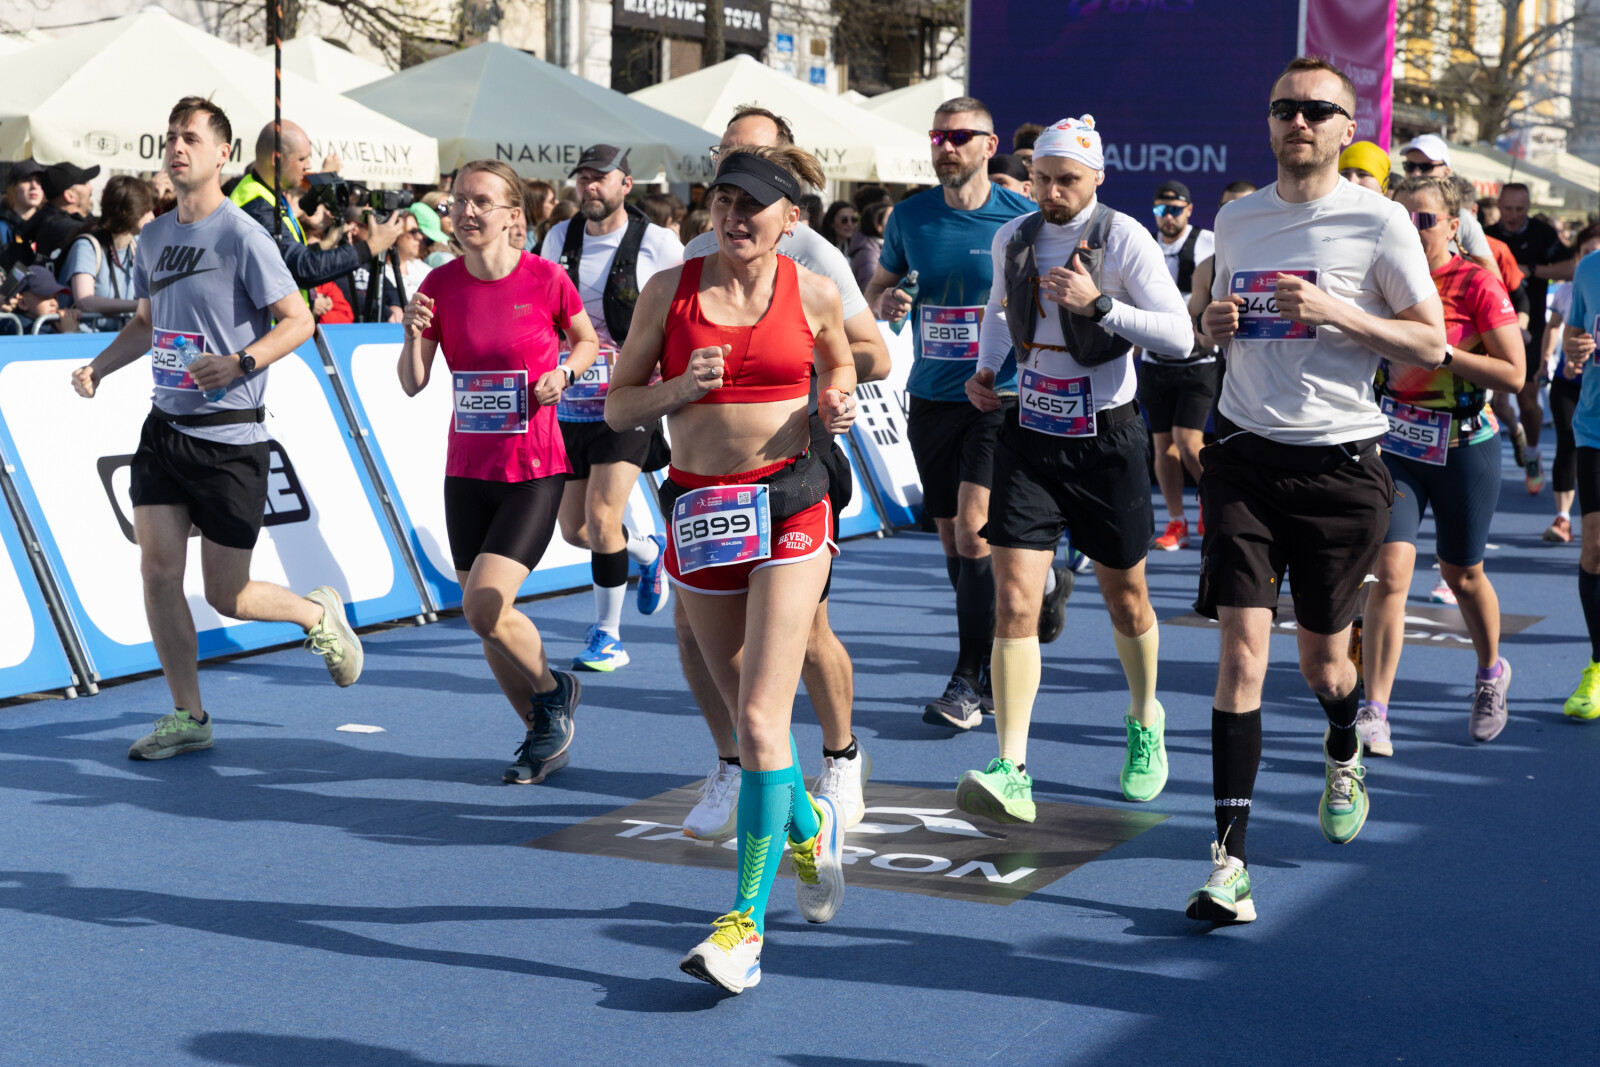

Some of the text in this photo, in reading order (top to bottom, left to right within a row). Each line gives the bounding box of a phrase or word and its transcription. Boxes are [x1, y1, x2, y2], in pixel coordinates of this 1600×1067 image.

[309, 138, 412, 164] NAKIELNY
[1102, 143, 1228, 173] AURON
[155, 245, 206, 273] RUN
[929, 326, 970, 340] 2812
[459, 395, 511, 410] 4226
[1025, 393, 1078, 415] 4657
[679, 514, 750, 543] 5899
[777, 531, 813, 548] BEVERLY
[785, 541, 806, 551] HILLS
